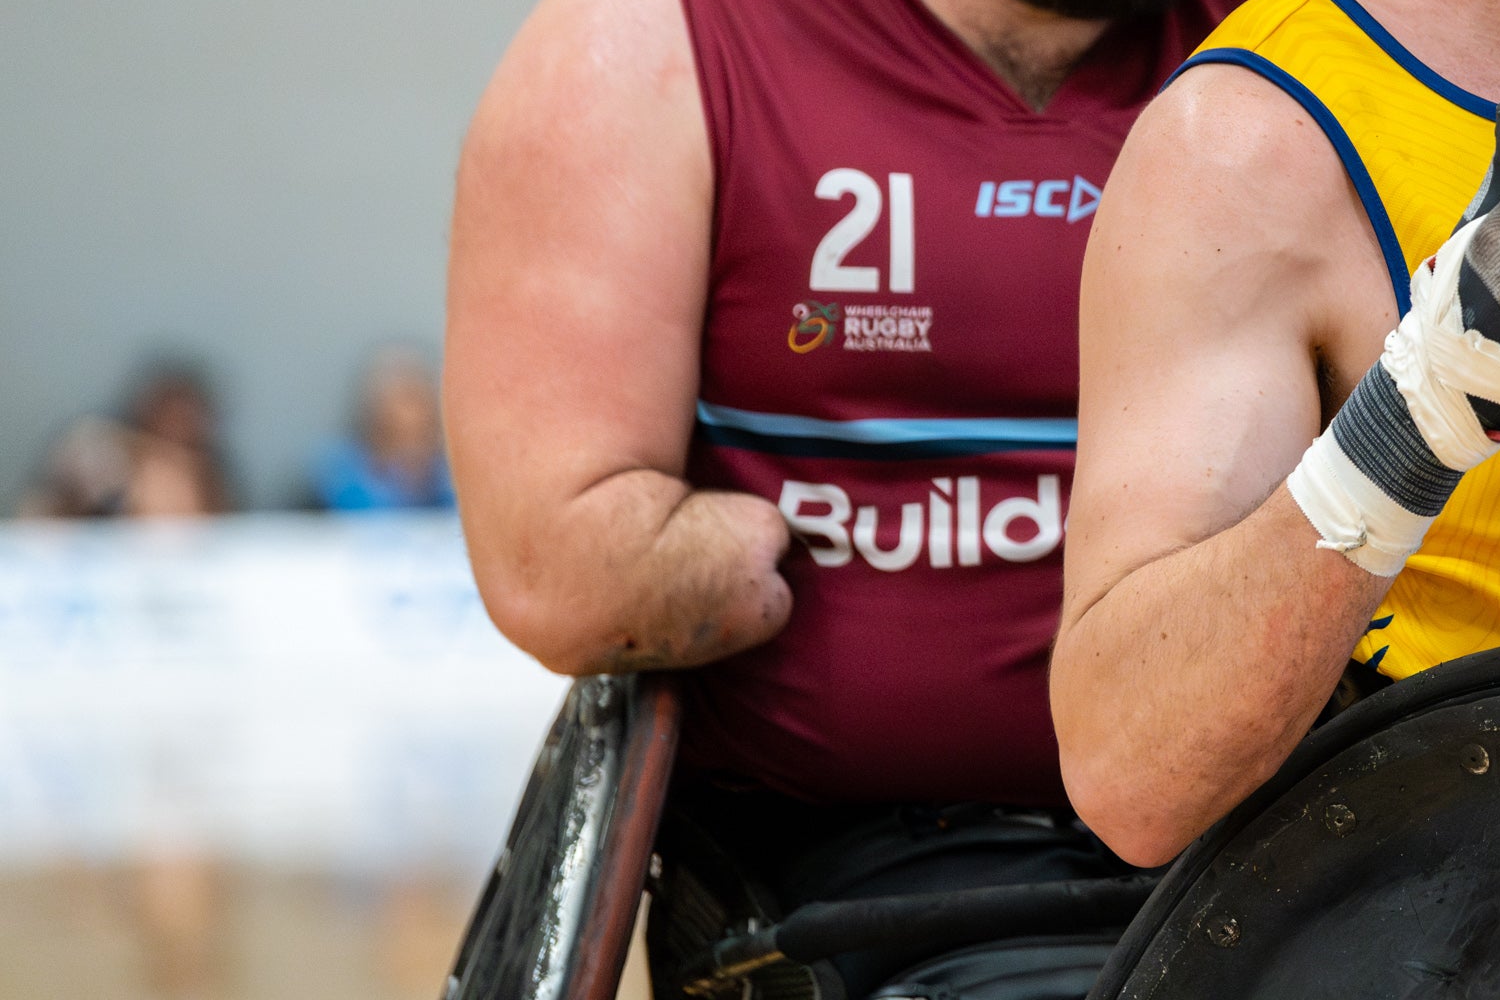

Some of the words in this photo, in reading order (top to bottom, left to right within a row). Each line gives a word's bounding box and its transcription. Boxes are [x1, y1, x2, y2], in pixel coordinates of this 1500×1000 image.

[809, 168, 915, 293] 21
[975, 180, 1070, 218] ISC
[844, 317, 932, 338] RUGBY
[778, 474, 1068, 572] Build
